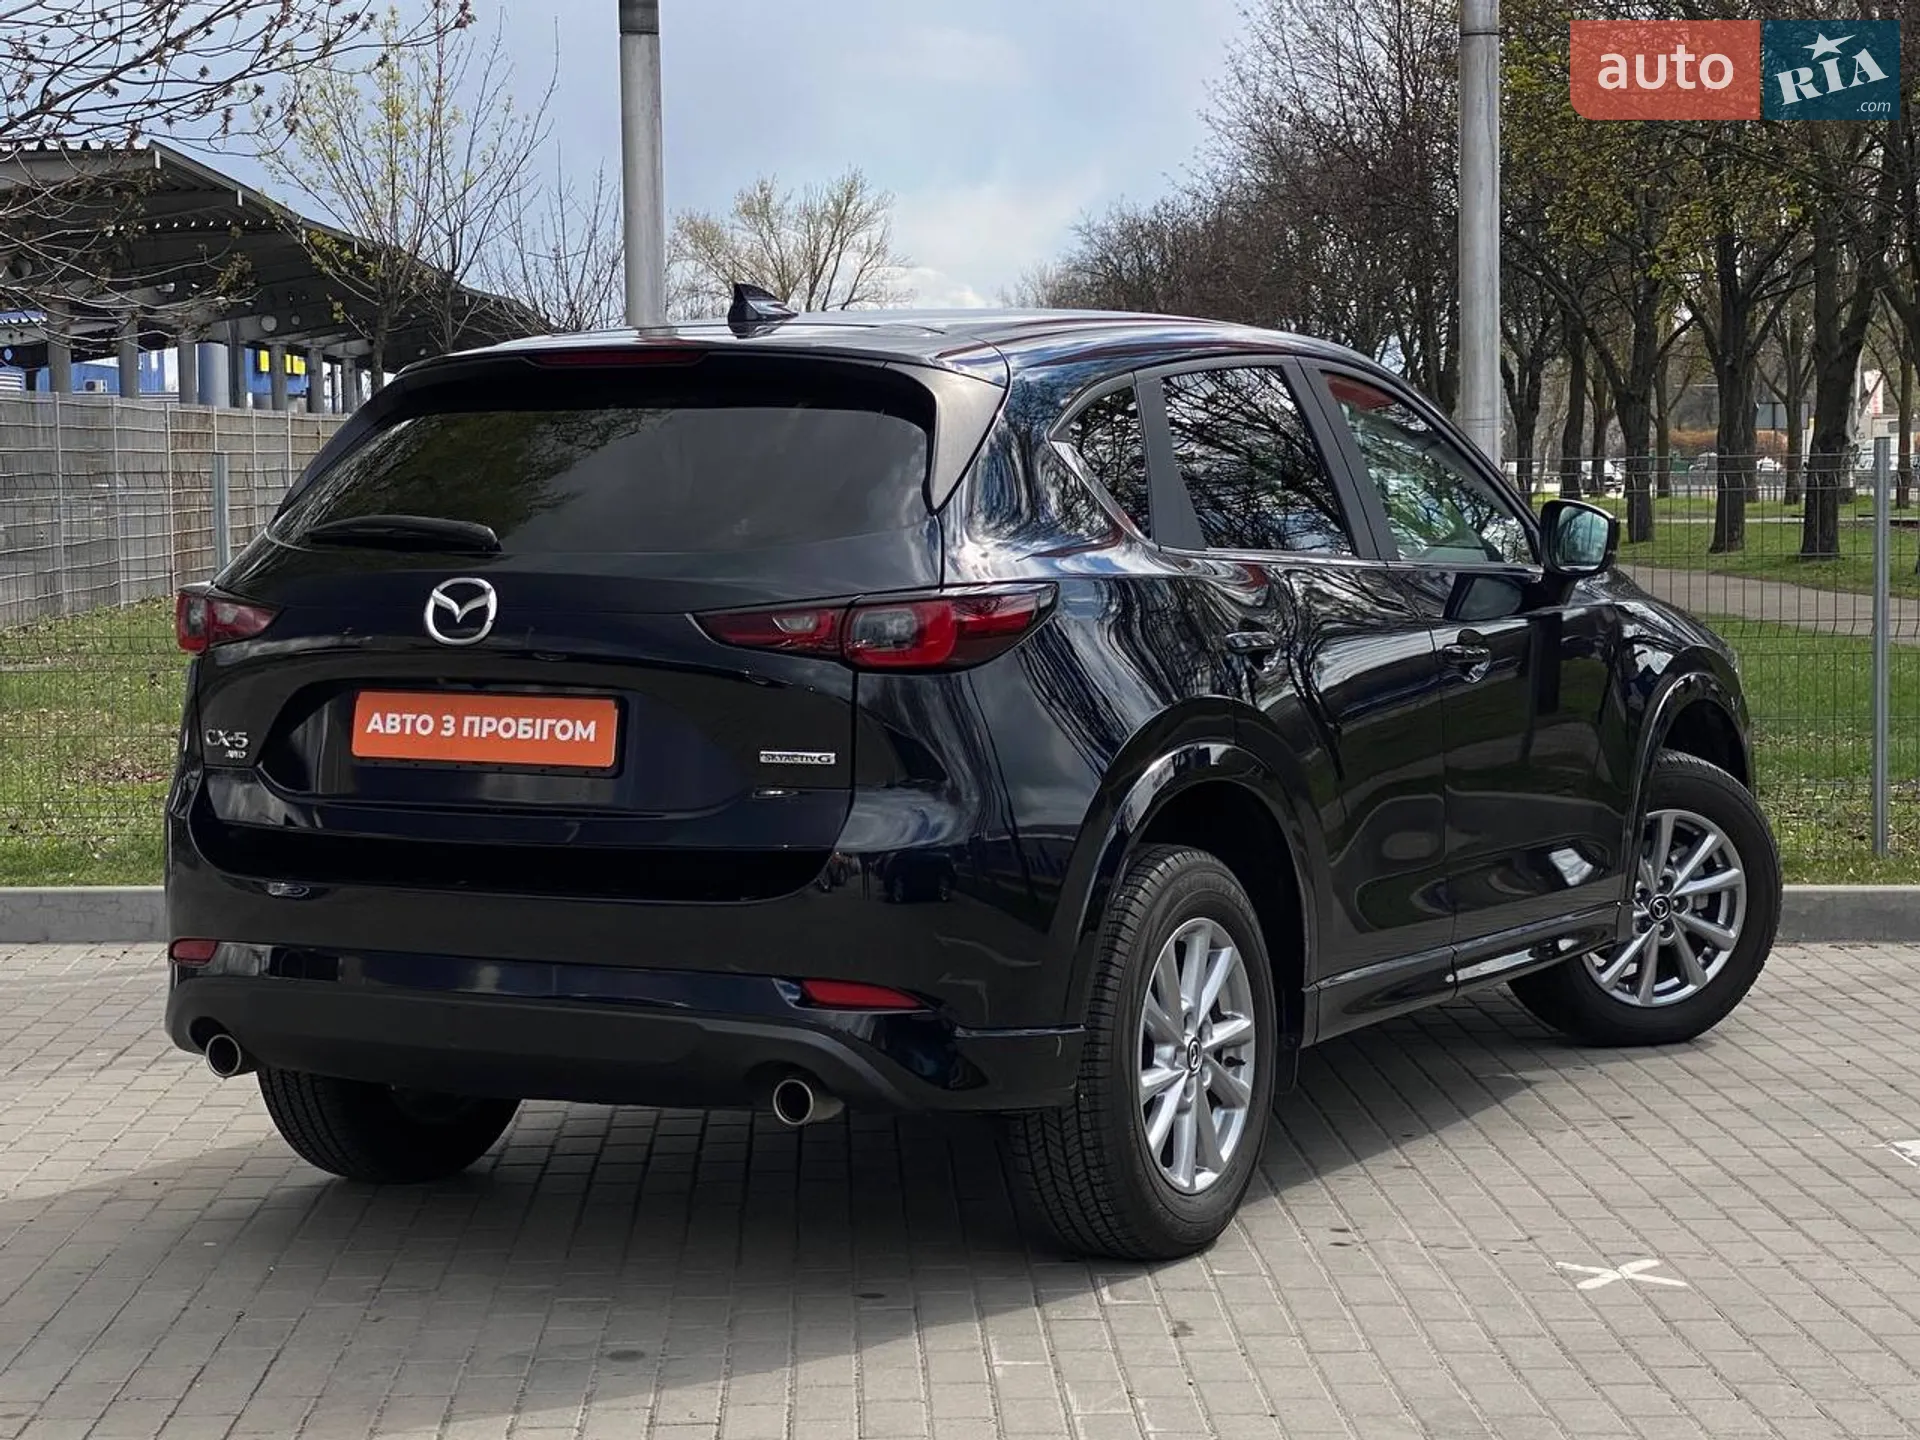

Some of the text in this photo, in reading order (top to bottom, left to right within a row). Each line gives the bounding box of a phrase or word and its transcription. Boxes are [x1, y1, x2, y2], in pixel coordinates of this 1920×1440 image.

[206, 729, 249, 749] CX-5
[366, 712, 434, 736] АВТО
[462, 716, 596, 742] ПРОБІГОМ
